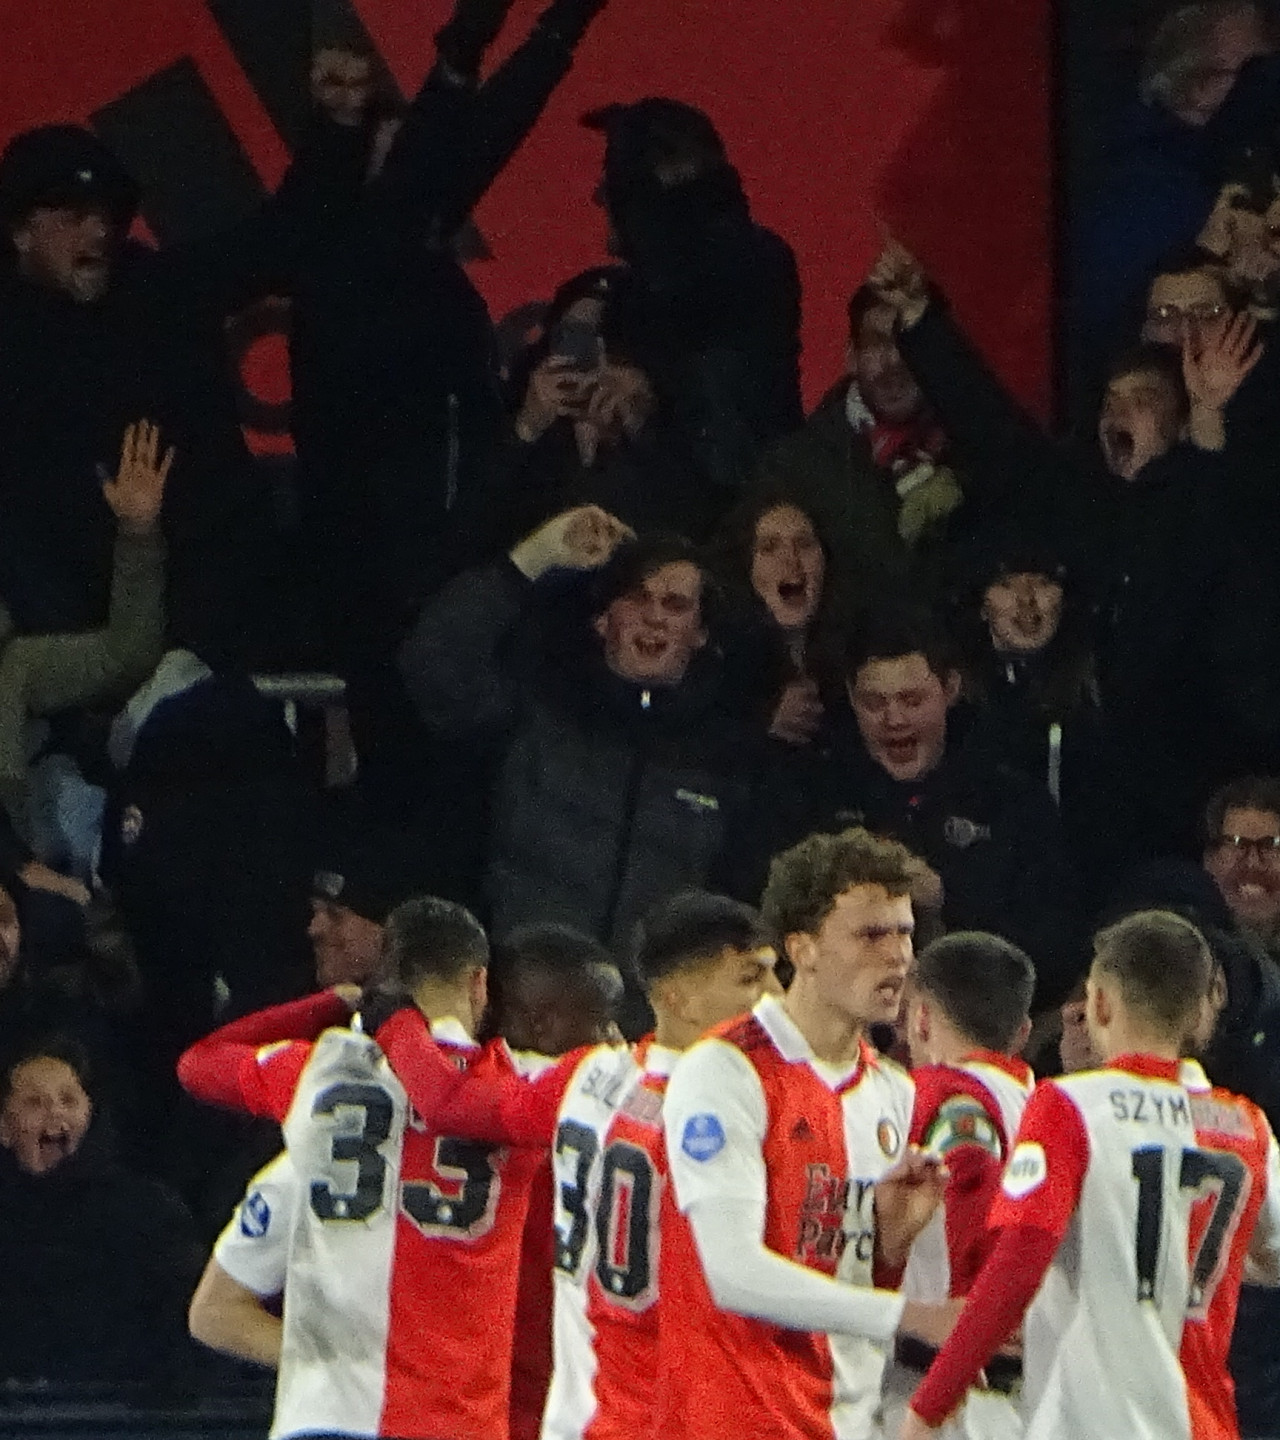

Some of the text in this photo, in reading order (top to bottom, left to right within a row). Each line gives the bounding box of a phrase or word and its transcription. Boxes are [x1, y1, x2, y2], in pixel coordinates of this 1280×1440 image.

[555, 1117, 658, 1306] 30
[795, 1226, 874, 1263] Parc
[800, 1163, 874, 1217] Eur
[1130, 1144, 1250, 1312] 17
